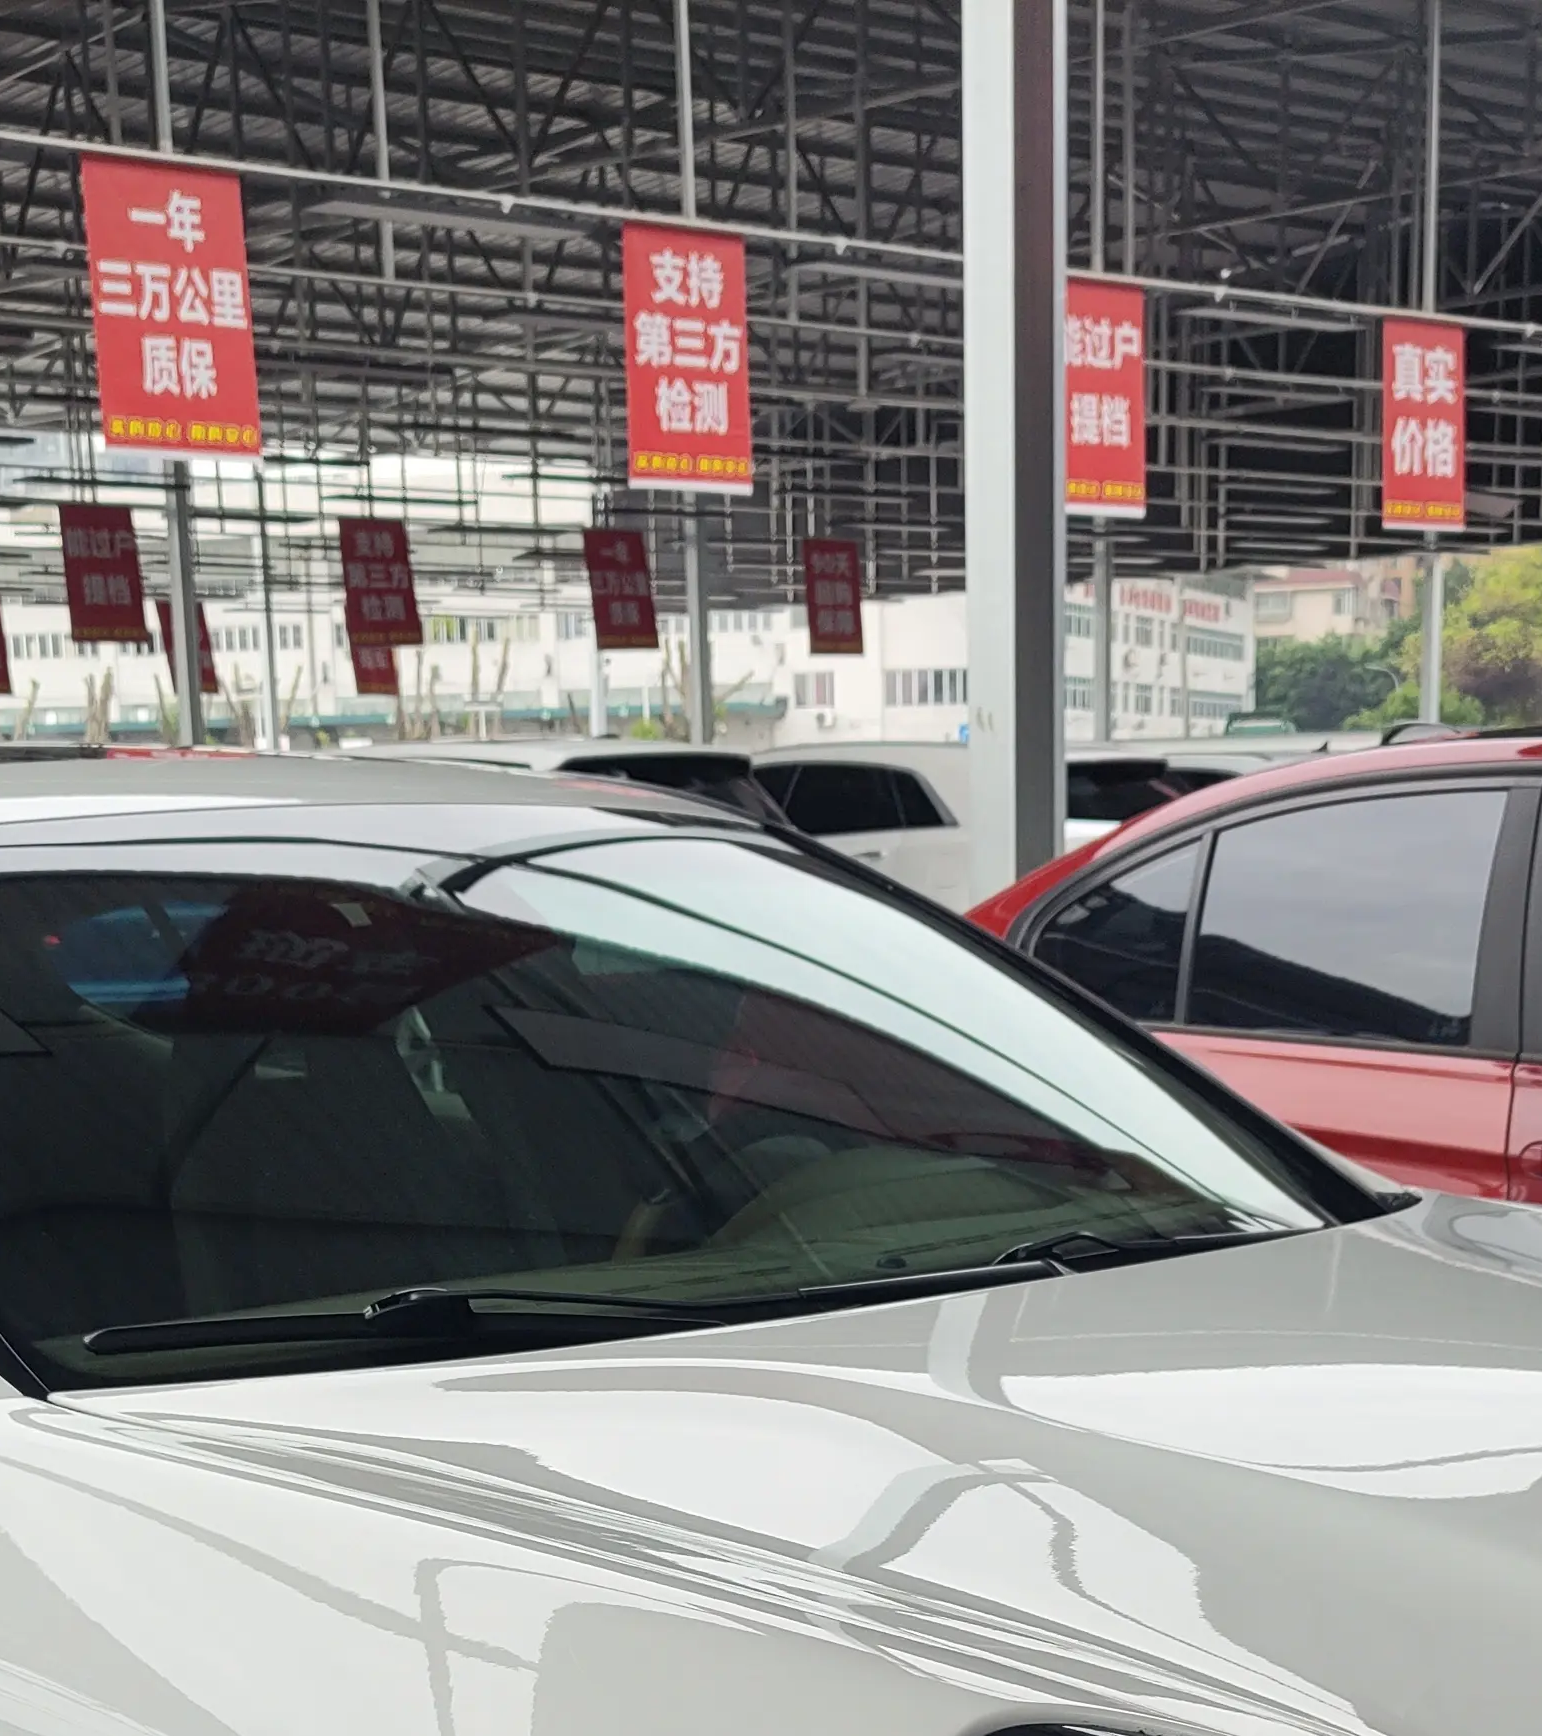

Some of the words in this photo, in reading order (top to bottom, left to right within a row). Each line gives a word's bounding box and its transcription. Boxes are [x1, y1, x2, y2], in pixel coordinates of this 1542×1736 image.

[127, 188, 205, 254] 一年
[97, 258, 248, 330] 三万公里
[649, 247, 724, 308] 支持
[141, 334, 217, 400] 质保
[633, 310, 743, 375] 第三方
[1391, 342, 1457, 405] 真实
[655, 375, 729, 436] 检测
[1391, 416, 1457, 478] 价格
